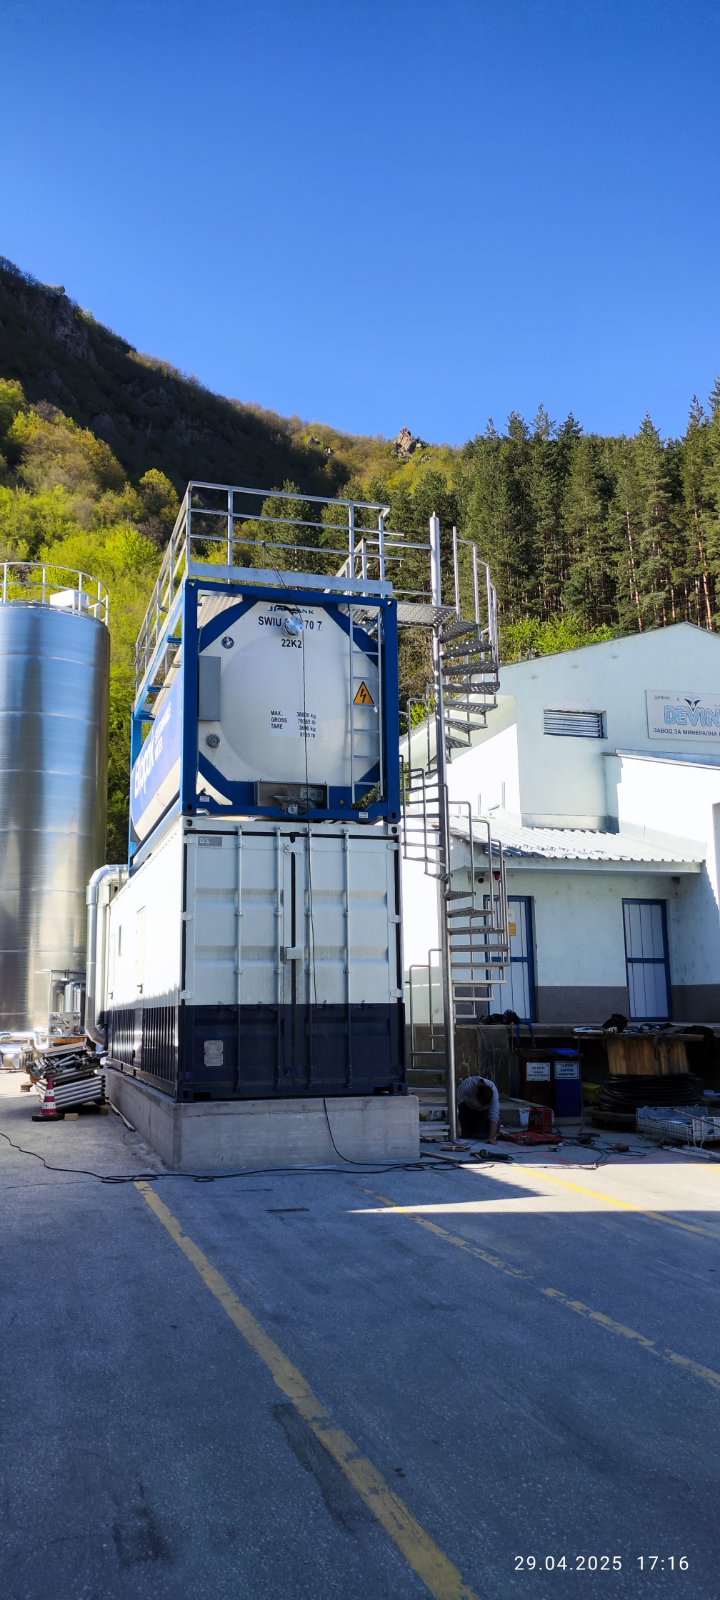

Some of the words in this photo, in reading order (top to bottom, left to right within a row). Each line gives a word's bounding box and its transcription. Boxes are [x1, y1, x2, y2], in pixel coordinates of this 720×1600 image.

[258, 616, 282, 627] SWIU
[281, 638, 303, 649] 22K2
[664, 705, 720, 728] DEVIN
[653, 727, 673, 735] ЗАВОД
[682, 729, 718, 737] МИНЕРАЛНА
